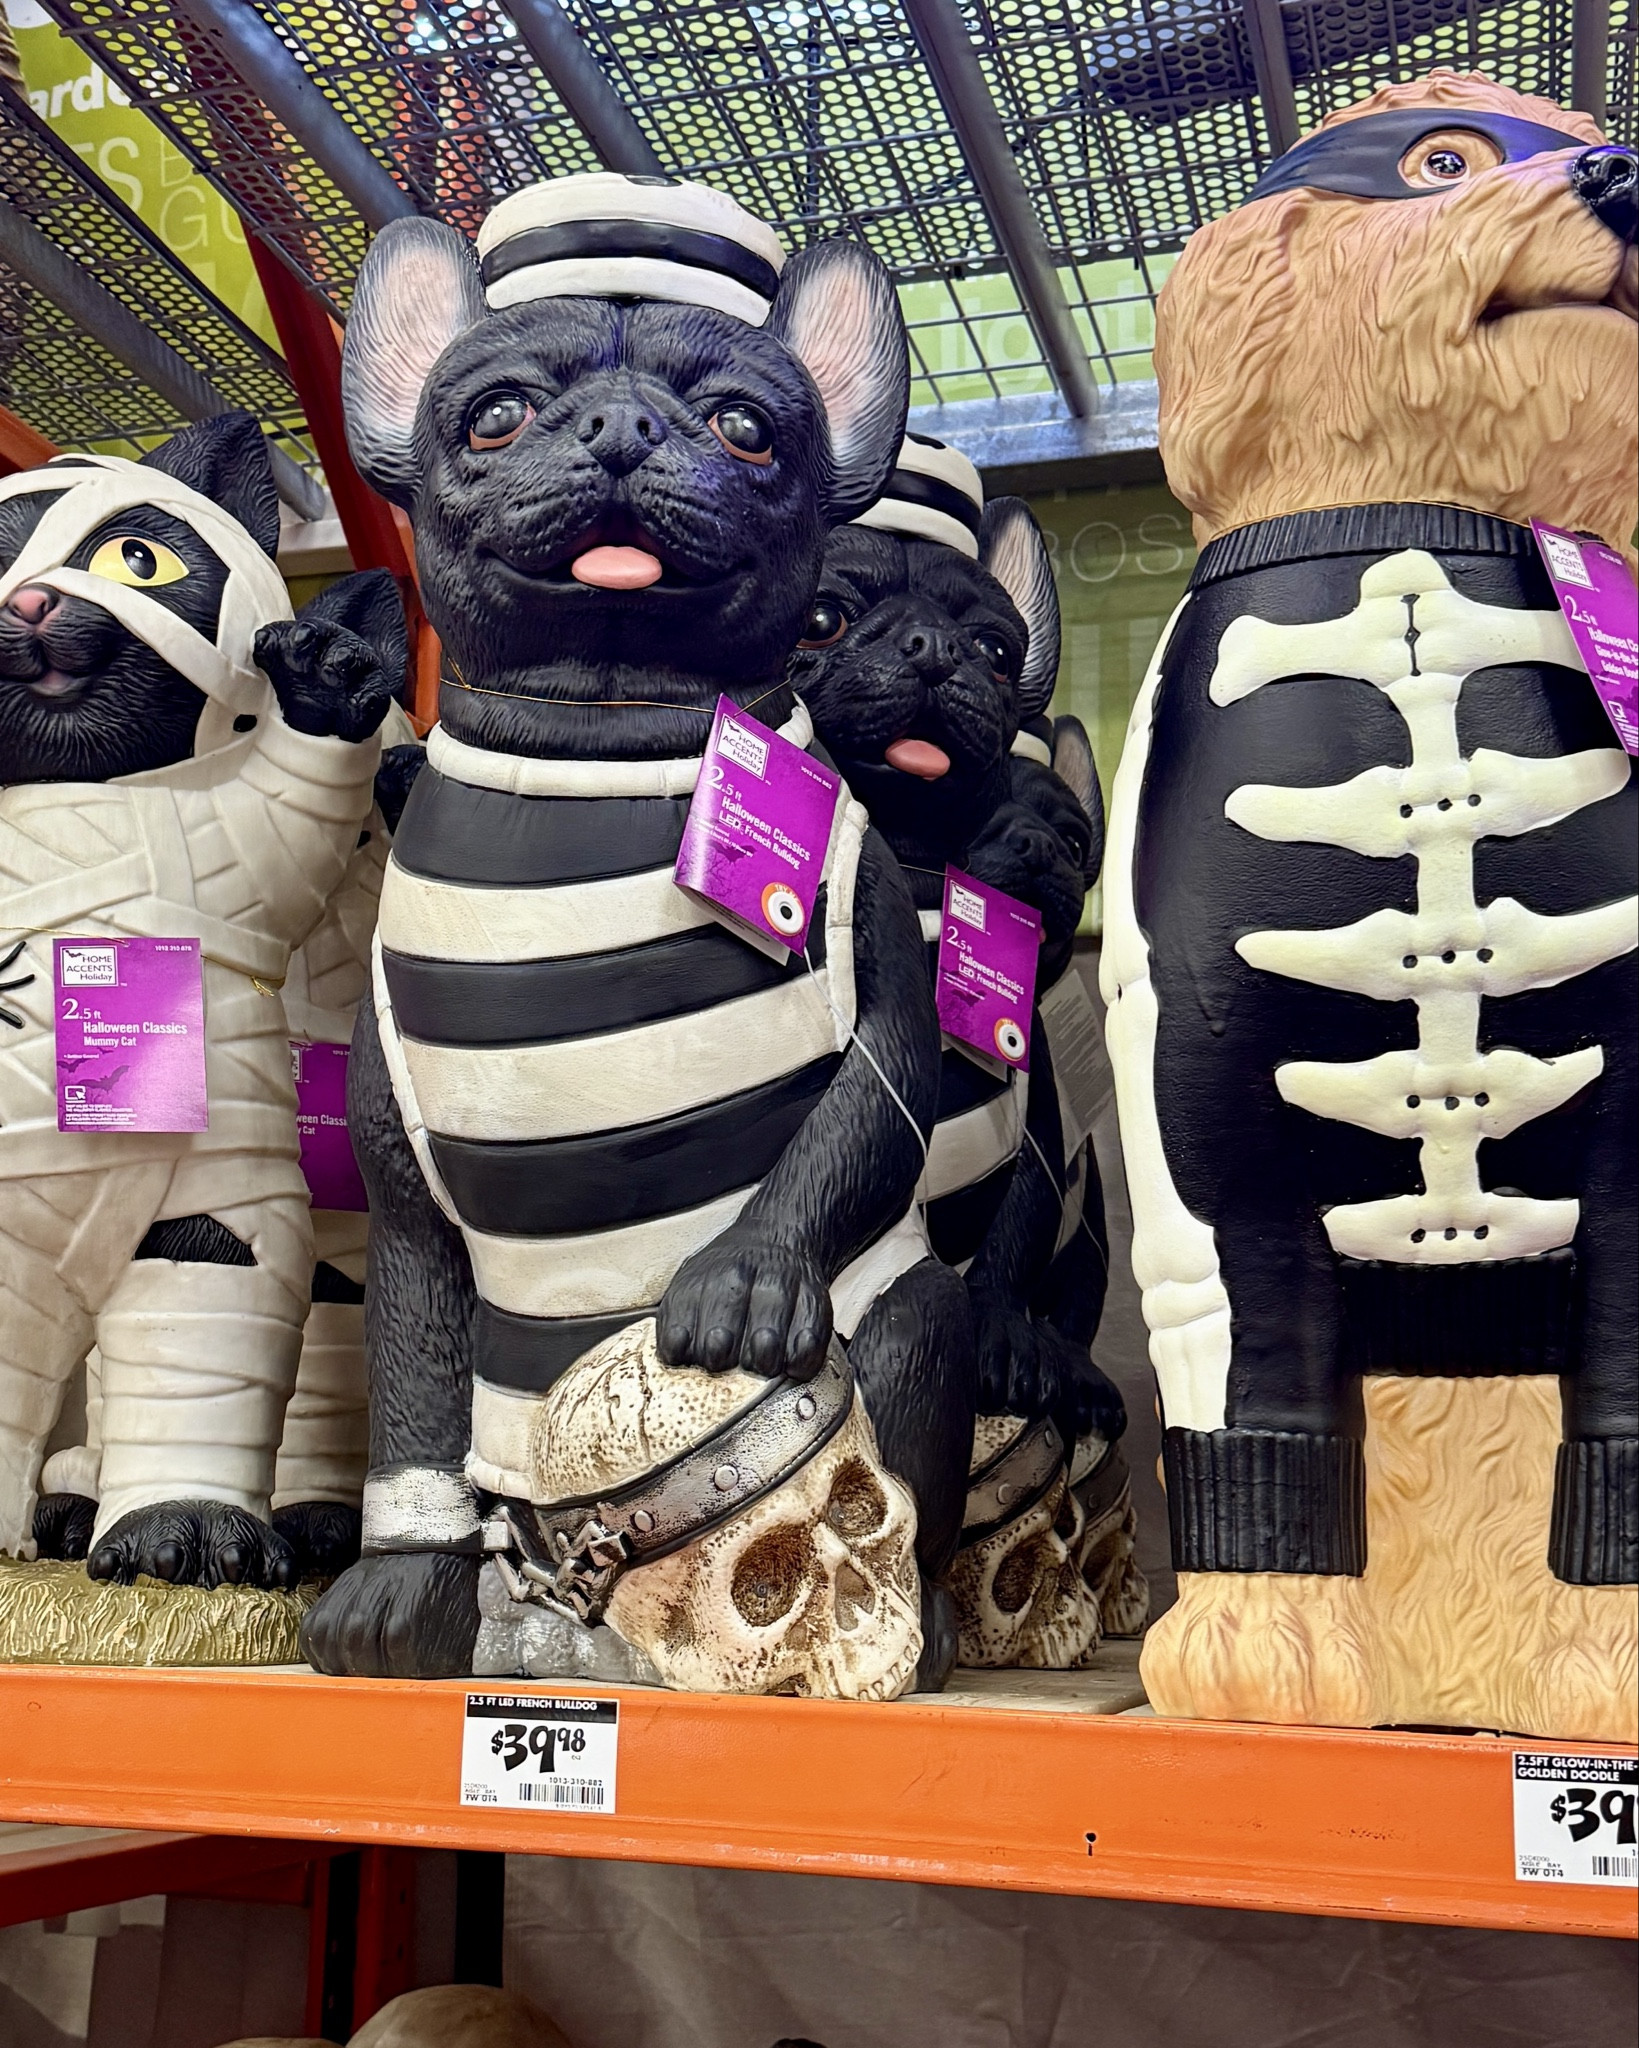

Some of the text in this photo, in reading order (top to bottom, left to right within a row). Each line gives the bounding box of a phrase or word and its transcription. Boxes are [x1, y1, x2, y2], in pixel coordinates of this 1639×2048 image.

[722, 735, 763, 765] ACCENTS
[738, 734, 764, 755] HOME
[732, 748, 761, 772] Holiday
[705, 765, 735, 795] 2.5
[721, 796, 772, 835] Halloween
[773, 827, 811, 861] Classics
[718, 810, 742, 831] LED
[744, 824, 772, 849] French
[771, 842, 801, 870] Bulldog
[82, 955, 112, 963] HOME
[80, 973, 113, 982] Holiday
[959, 950, 996, 979] Halloween
[996, 971, 1024, 995] Classics
[958, 963, 975, 979] LED
[976, 973, 997, 991] French
[997, 984, 1018, 1004] Bulldog
[62, 998, 102, 1020] 2.5 ft
[83, 1021, 188, 1035] Halloween Classics
[83, 1036, 137, 1048] Mummy Cat
[302, 1125, 316, 1135] Cat
[469, 1696, 598, 1711] 2.5 FT LED FRENCH BULLDOG
[1517, 1756, 1638, 1771] 2.5FT GLOW-IN-THE-
[1517, 1767, 1620, 1782] GOLDEN DOODLE
[1542, 1868, 1564, 1877] 014
